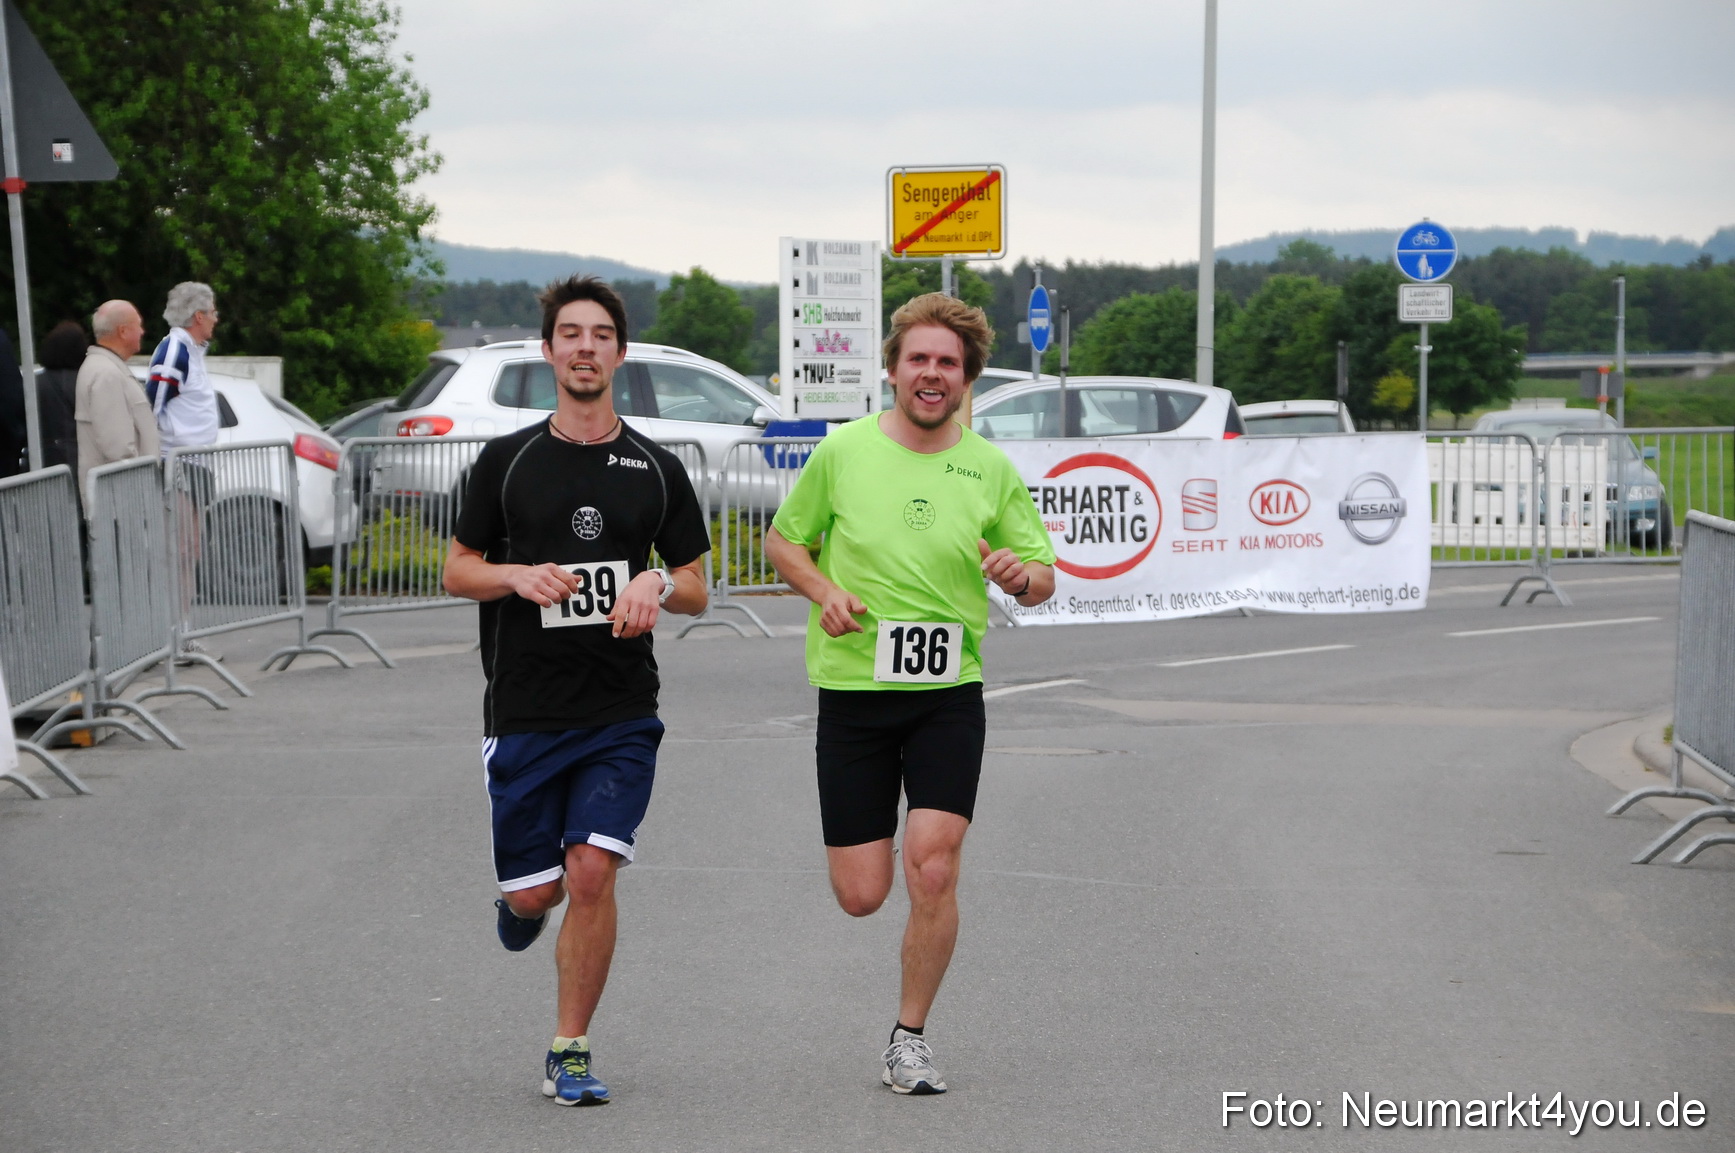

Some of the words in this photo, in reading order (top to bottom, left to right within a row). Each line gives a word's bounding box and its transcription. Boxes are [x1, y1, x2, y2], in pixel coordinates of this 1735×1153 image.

[902, 181, 991, 207] Sengenthal
[914, 210, 934, 221] am
[941, 209, 979, 223] Anger
[924, 231, 963, 243] Neumarkt
[823, 242, 862, 255] HOLZAMMER
[823, 272, 862, 285] HOLZAMMER
[803, 303, 823, 325] SHB
[1406, 307, 1433, 316] Verkehr
[803, 363, 836, 384] THULE
[620, 456, 648, 470] DEKRA
[956, 466, 983, 481] DEKRA
[1028, 485, 1130, 514] ERHART
[1134, 491, 1144, 506] &
[1260, 491, 1299, 516] KIA
[1345, 501, 1401, 516] NISSAN
[1064, 514, 1148, 545] JÄNIG
[1172, 539, 1229, 553] SEAT
[1239, 535, 1261, 551] KIA
[1264, 532, 1324, 550] MOTORS
[1069, 594, 1136, 618] Sengenthal
[1146, 592, 1168, 612] Tel.
[1265, 583, 1421, 608] www.gerhart-jaenig.de
[889, 625, 950, 676] 136
